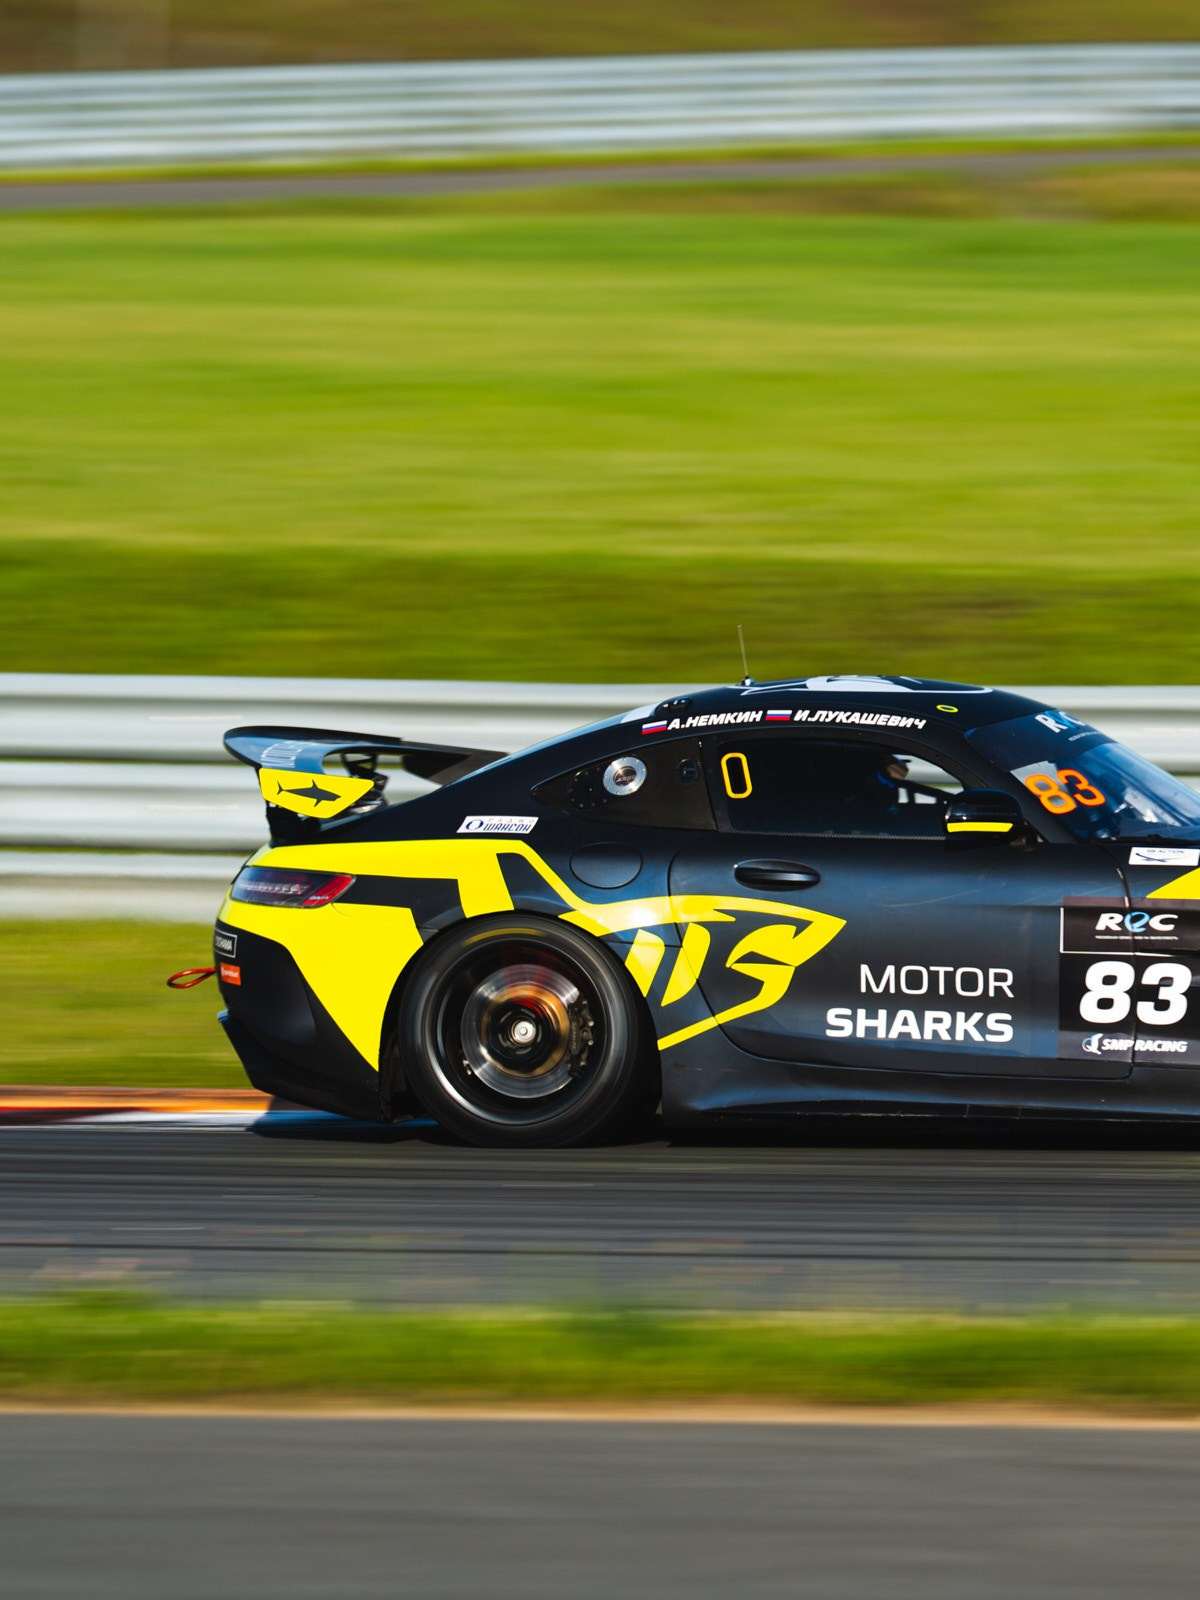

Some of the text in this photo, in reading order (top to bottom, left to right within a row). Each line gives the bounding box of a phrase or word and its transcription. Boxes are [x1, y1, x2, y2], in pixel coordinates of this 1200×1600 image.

[667, 709, 928, 731] А.НЕМКИН И.ЛУКАШЕВИЧ
[1024, 768, 1106, 815] 83
[483, 823, 532, 832] ШАНСОН
[859, 963, 1015, 998] MOTOR
[1079, 960, 1193, 1026] 83
[825, 1007, 1014, 1042] SHARKS
[1101, 1038, 1188, 1053] SMP RACING
